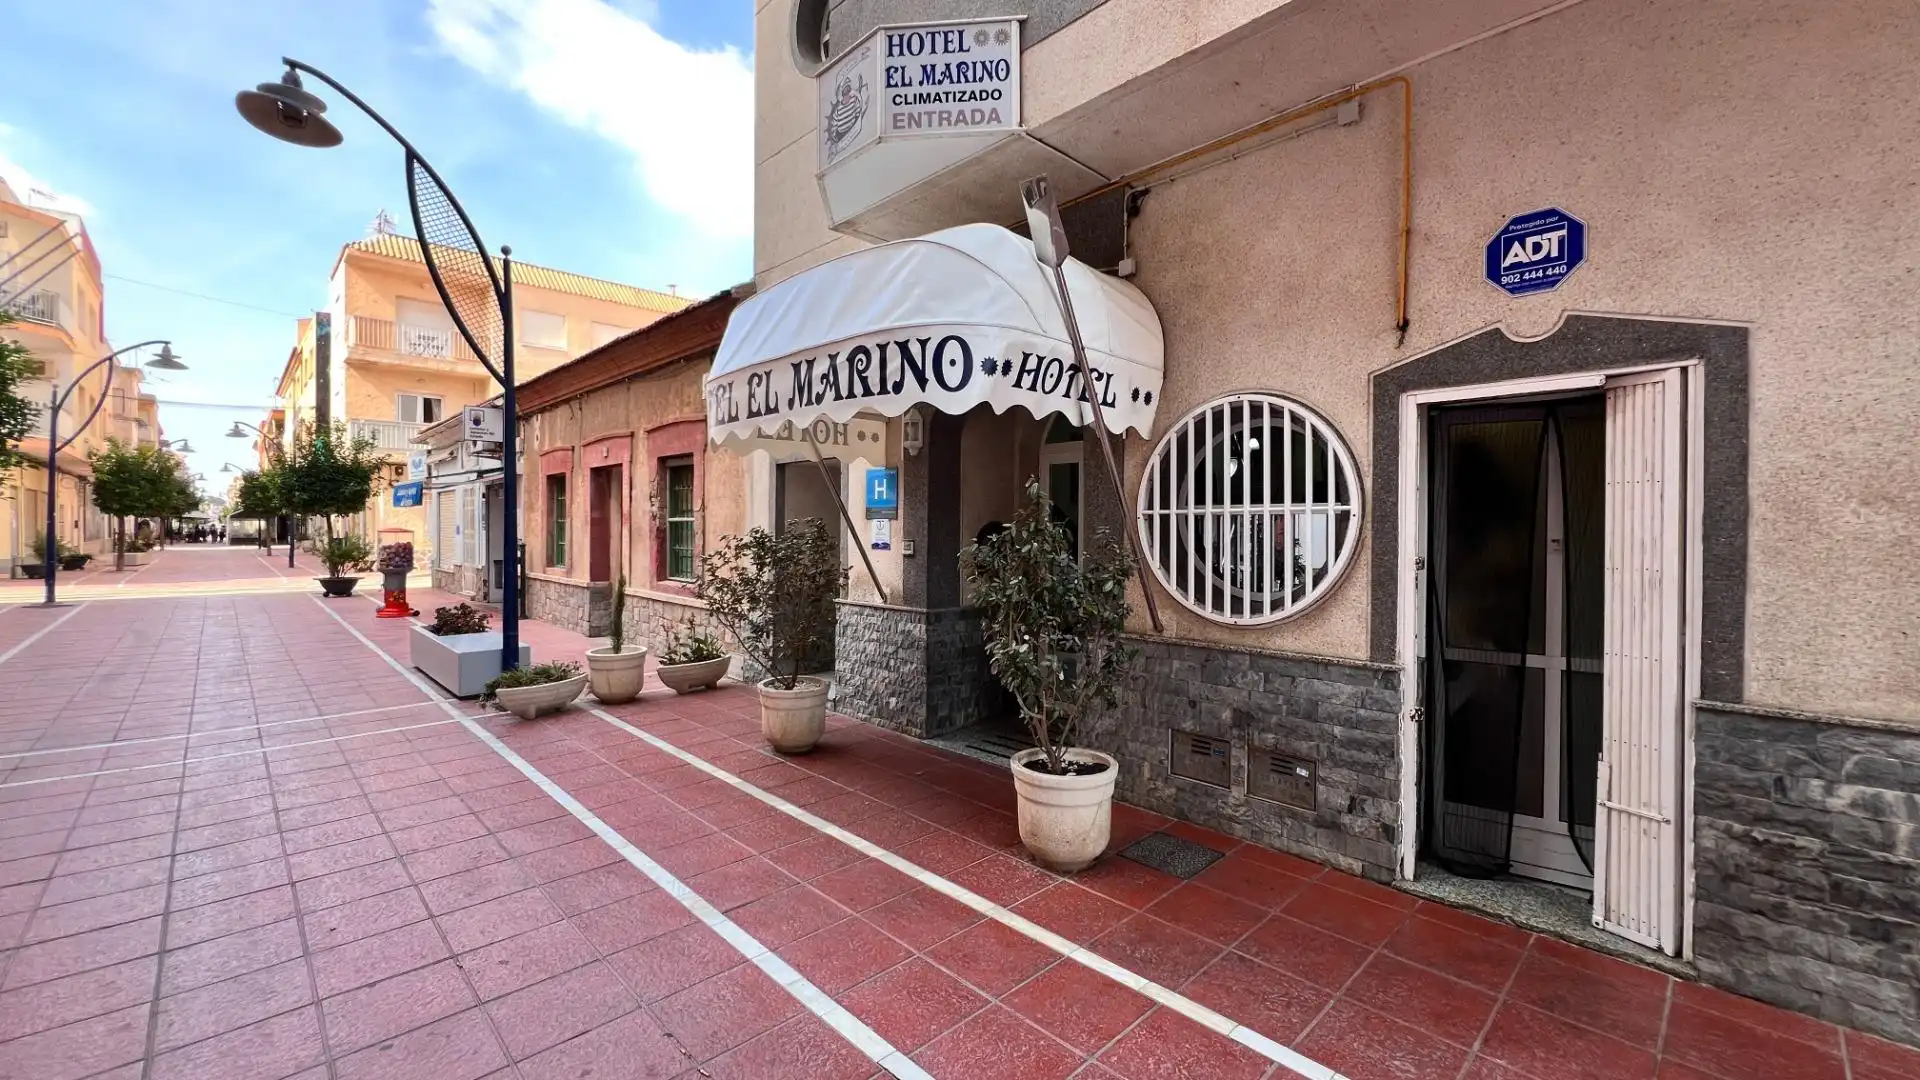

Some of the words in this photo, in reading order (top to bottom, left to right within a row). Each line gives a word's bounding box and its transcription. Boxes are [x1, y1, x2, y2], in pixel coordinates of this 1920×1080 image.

[886, 29, 971, 58] HOTEL
[885, 65, 913, 88] EL
[918, 58, 1010, 86] MARINO
[892, 88, 1002, 106] CLIMATIZADO
[892, 107, 1002, 130] ENTRADA
[1509, 219, 1545, 231] Protegido
[1546, 215, 1559, 224] por
[1502, 229, 1567, 268] ADT
[1501, 274, 1520, 284] 902
[1522, 270, 1543, 280] 444
[1545, 265, 1567, 275] 440
[711, 380, 740, 426] EL
[746, 369, 780, 419] EL
[788, 335, 973, 411] MARINO
[1011, 351, 1117, 408] HOTEL
[874, 478, 887, 500] H
